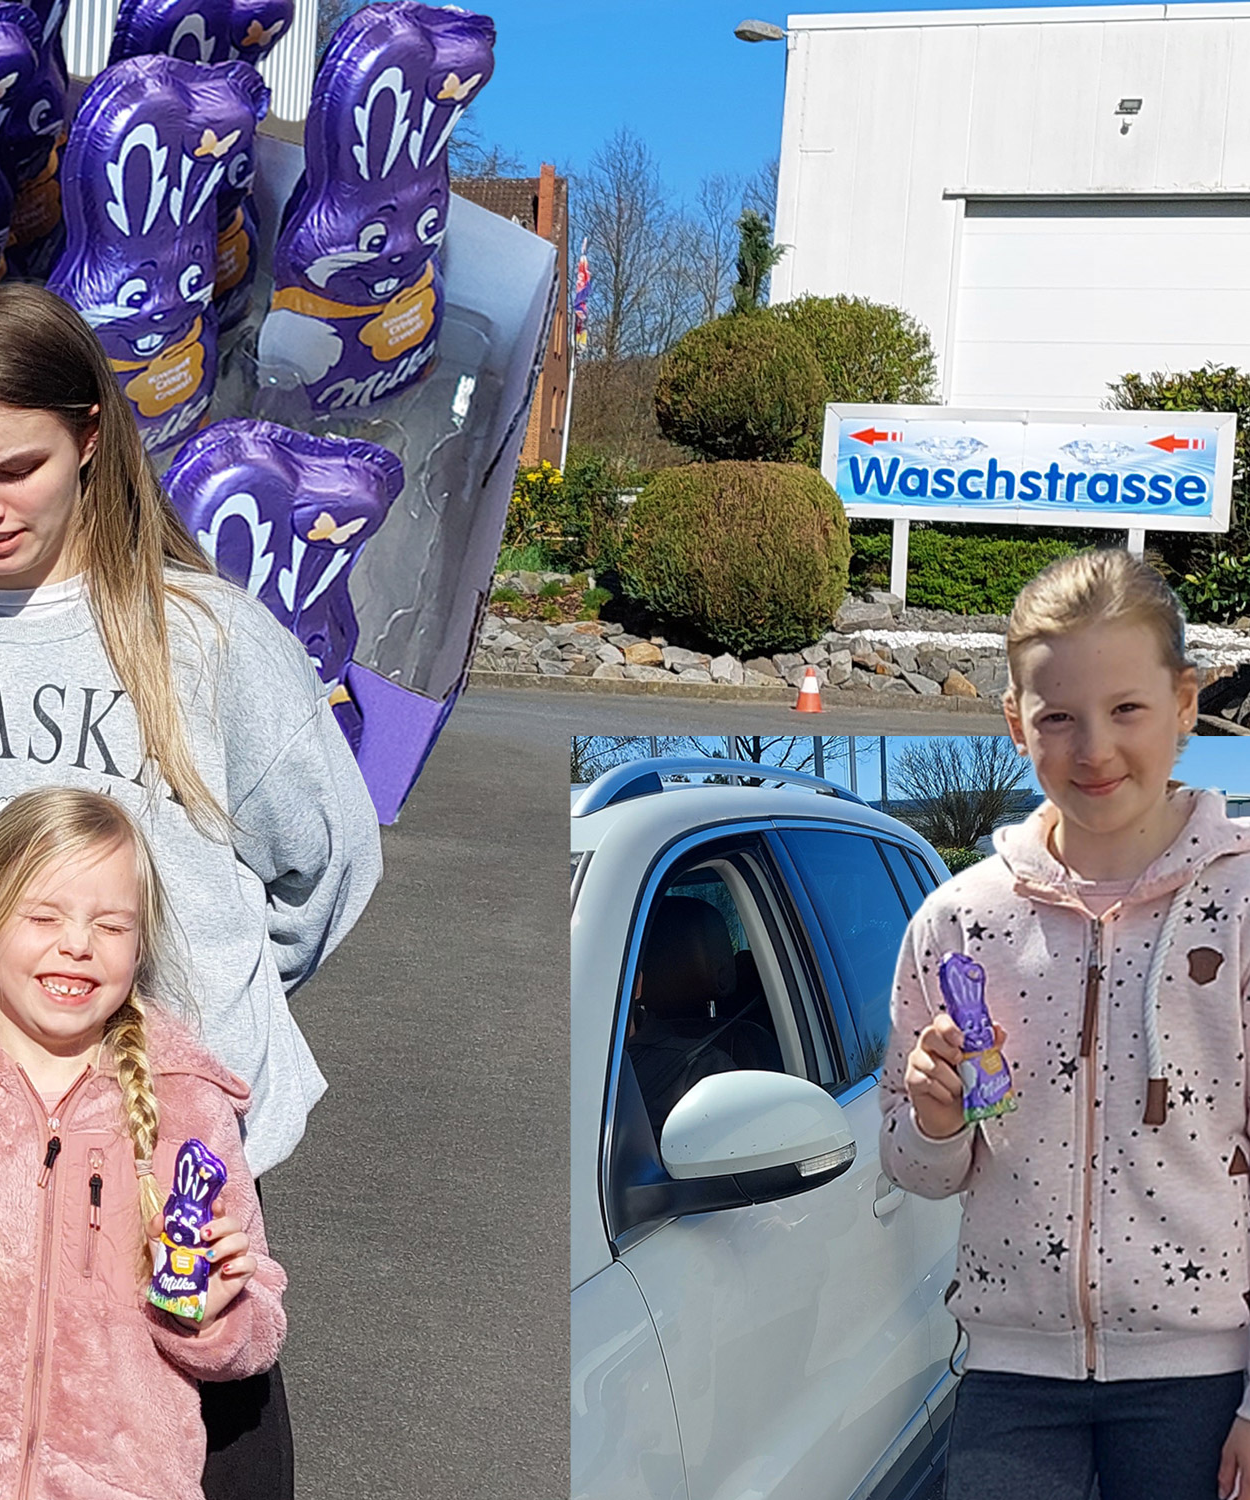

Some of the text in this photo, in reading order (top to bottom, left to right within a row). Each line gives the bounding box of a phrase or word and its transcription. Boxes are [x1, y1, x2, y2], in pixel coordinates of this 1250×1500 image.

[138, 394, 209, 452] ilka
[849, 455, 1207, 507] Waschstrasse
[158, 1272, 198, 1293] Milka
